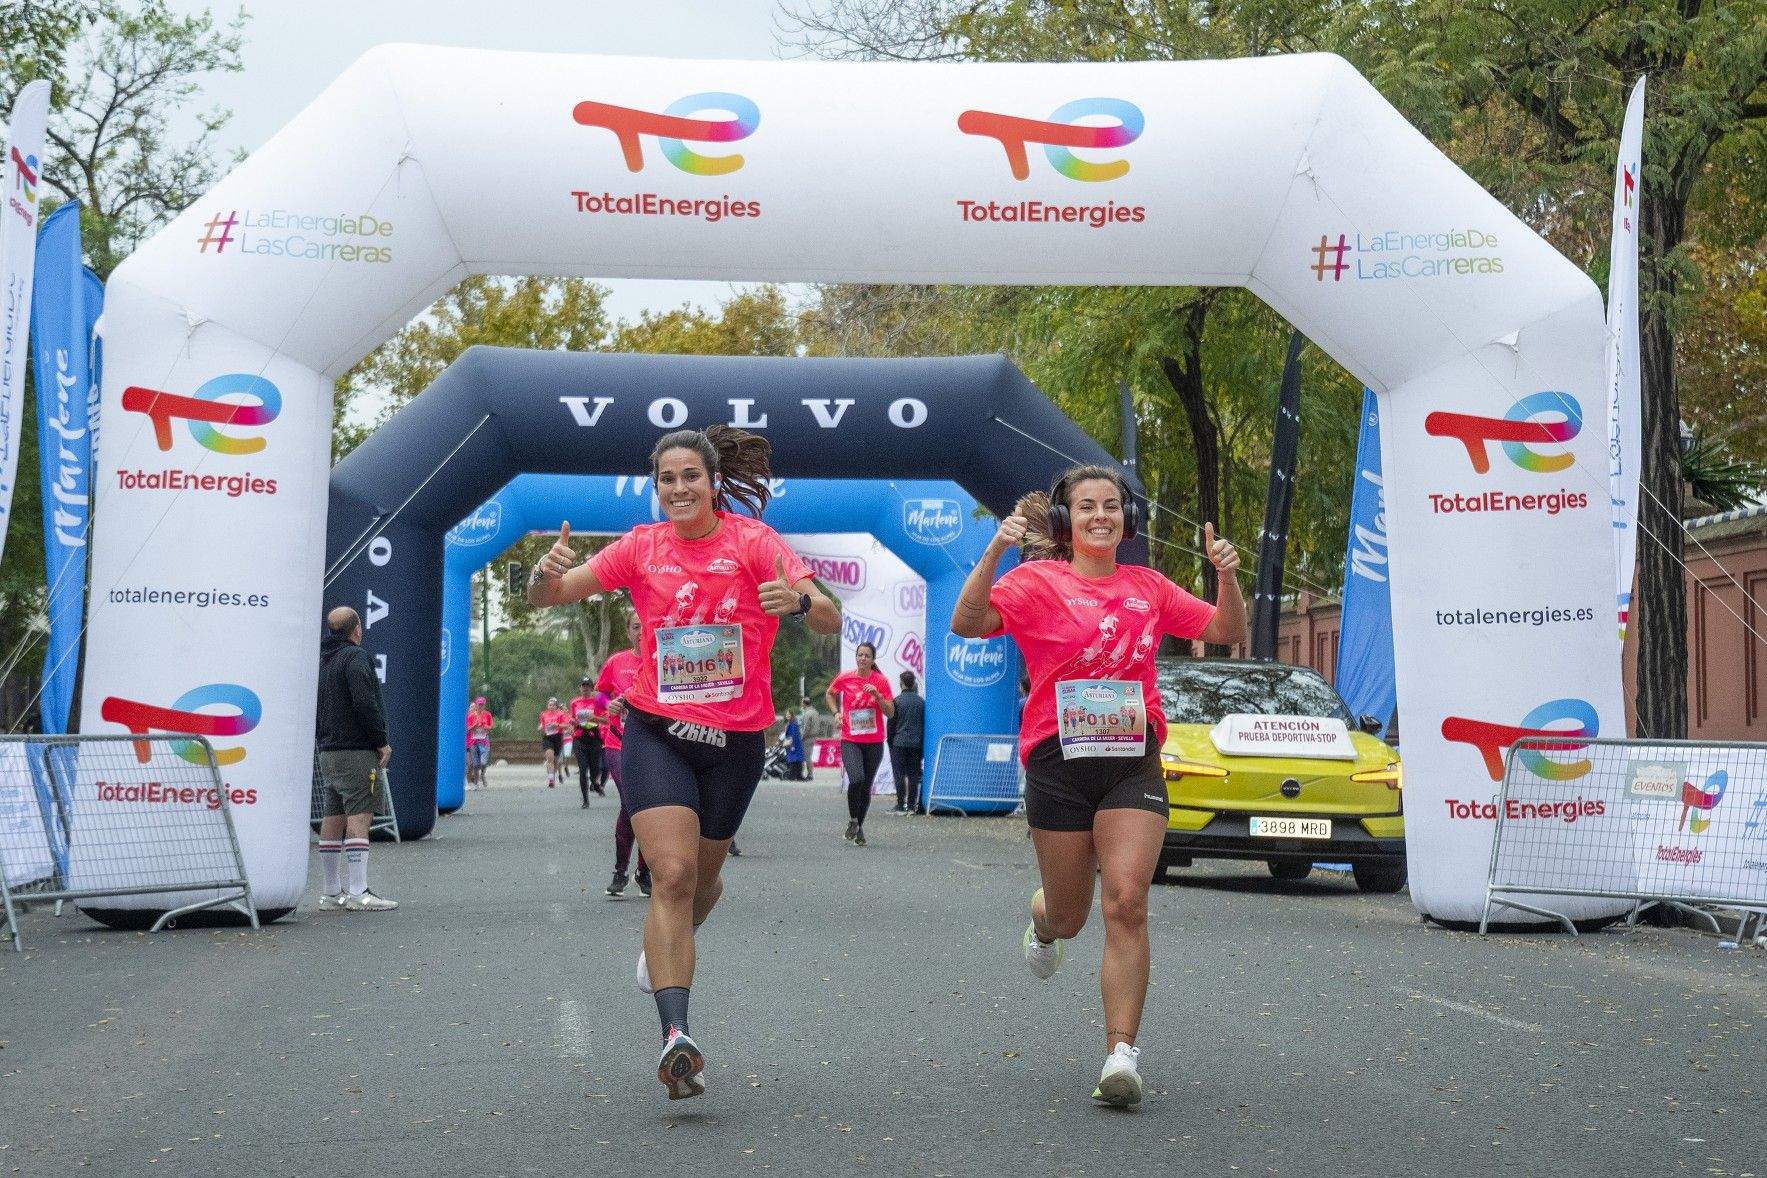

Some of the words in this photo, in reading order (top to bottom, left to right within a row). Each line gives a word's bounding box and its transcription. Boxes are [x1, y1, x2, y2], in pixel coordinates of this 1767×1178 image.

[571, 191, 761, 220] TotalEnergies
[957, 200, 1145, 228] TotalEnergies
[244, 209, 393, 237] LaEnergíaDe
[241, 233, 392, 263] LasCarreras
[1357, 228, 1497, 253] LaEnergíaDe
[1357, 256, 1504, 280] LasCarreras
[559, 395, 928, 430] VOLVO
[117, 470, 277, 497] TotalEnergies
[1429, 489, 1587, 515] TotalEnergies
[110, 587, 269, 608] totalenergies.es
[1436, 607, 1593, 625] totalenergies.es
[843, 612, 886, 651] OSMO
[685, 659, 716, 673] 016
[1087, 713, 1120, 726] 016
[1254, 719, 1320, 731] ATENCIÓN
[1238, 731, 1270, 742] PRUEBA
[1272, 732, 1337, 743] DEPORTIVA-STOP
[96, 781, 257, 810] TotalEnergies
[1445, 796, 1605, 823] TotaEnergies
[1261, 820, 1296, 834] 3898
